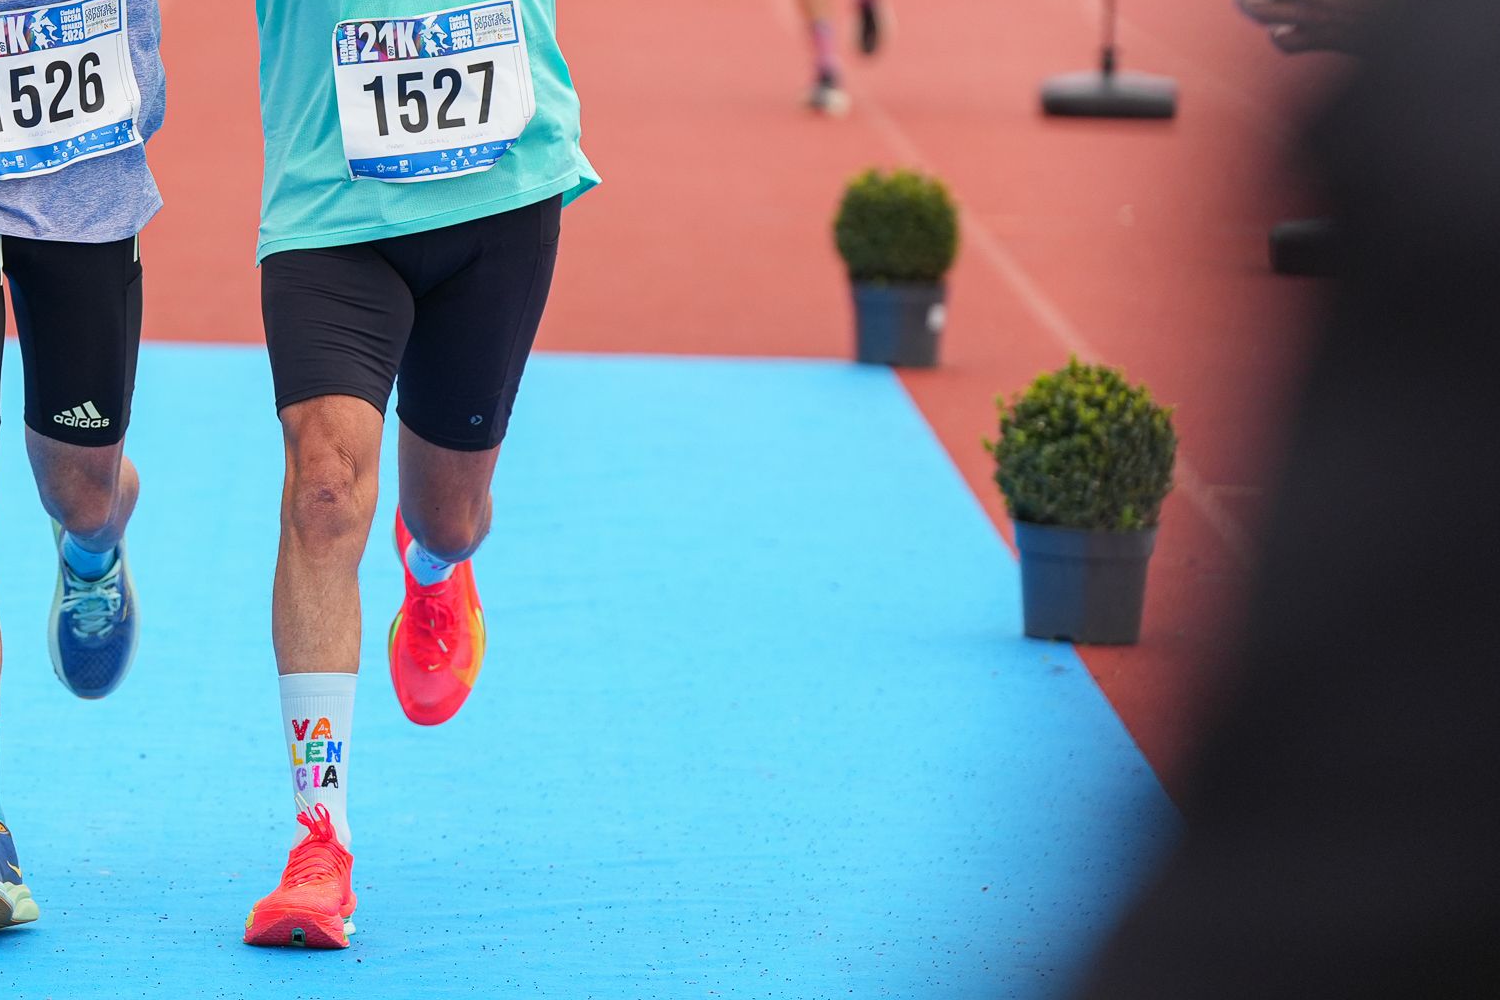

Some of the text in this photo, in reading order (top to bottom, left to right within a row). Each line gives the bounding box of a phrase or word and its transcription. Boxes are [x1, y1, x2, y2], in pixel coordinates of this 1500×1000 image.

[62, 28, 84, 43] 2026
[475, 17, 511, 31] populares
[358, 21, 419, 61] 21K
[452, 36, 473, 51] 2026
[363, 61, 494, 136] 1527
[53, 414, 110, 429] adidas
[291, 717, 333, 741] VA
[291, 741, 343, 766] LEN
[295, 765, 339, 791] CIA
